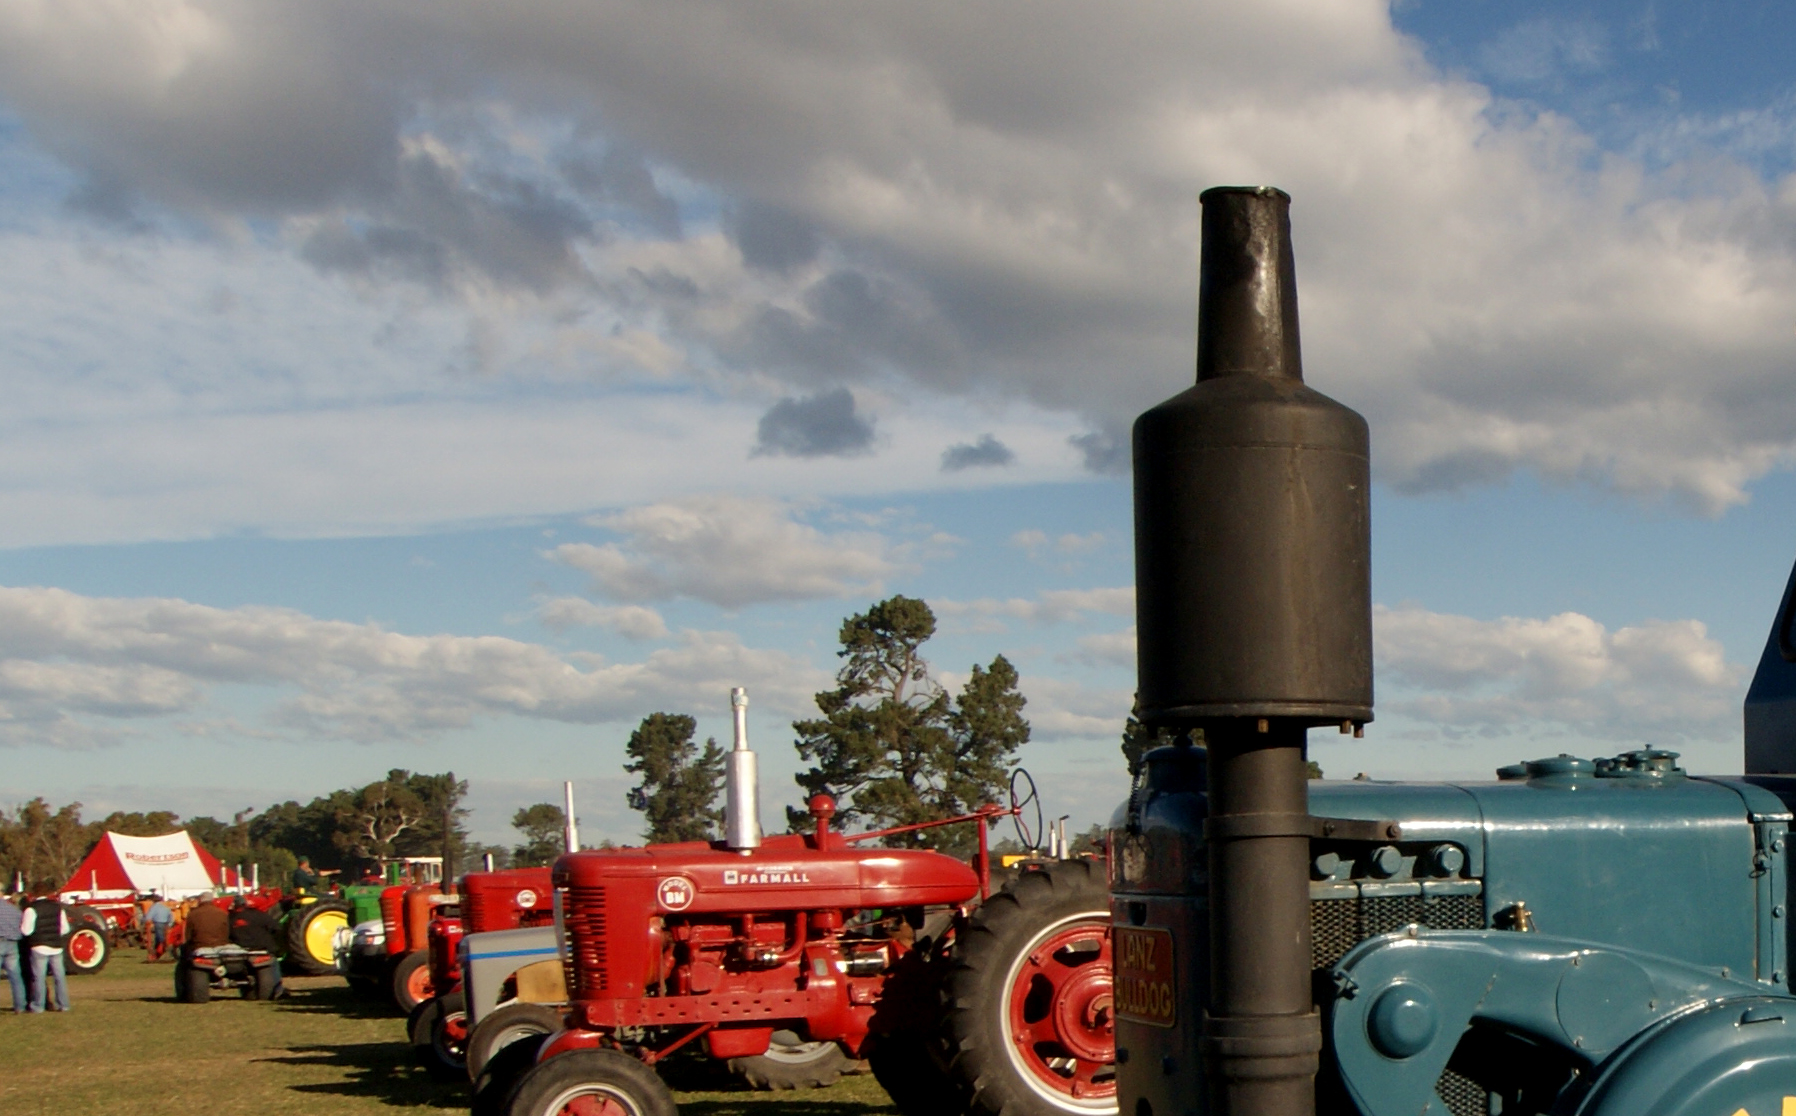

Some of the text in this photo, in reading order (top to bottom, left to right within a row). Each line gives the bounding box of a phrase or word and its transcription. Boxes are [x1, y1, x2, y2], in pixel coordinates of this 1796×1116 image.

[741, 874, 809, 884] FARMALL
[666, 892, 684, 903] BM
[1122, 935, 1156, 971] LANZ
[1115, 975, 1171, 1017] BULLDOG
